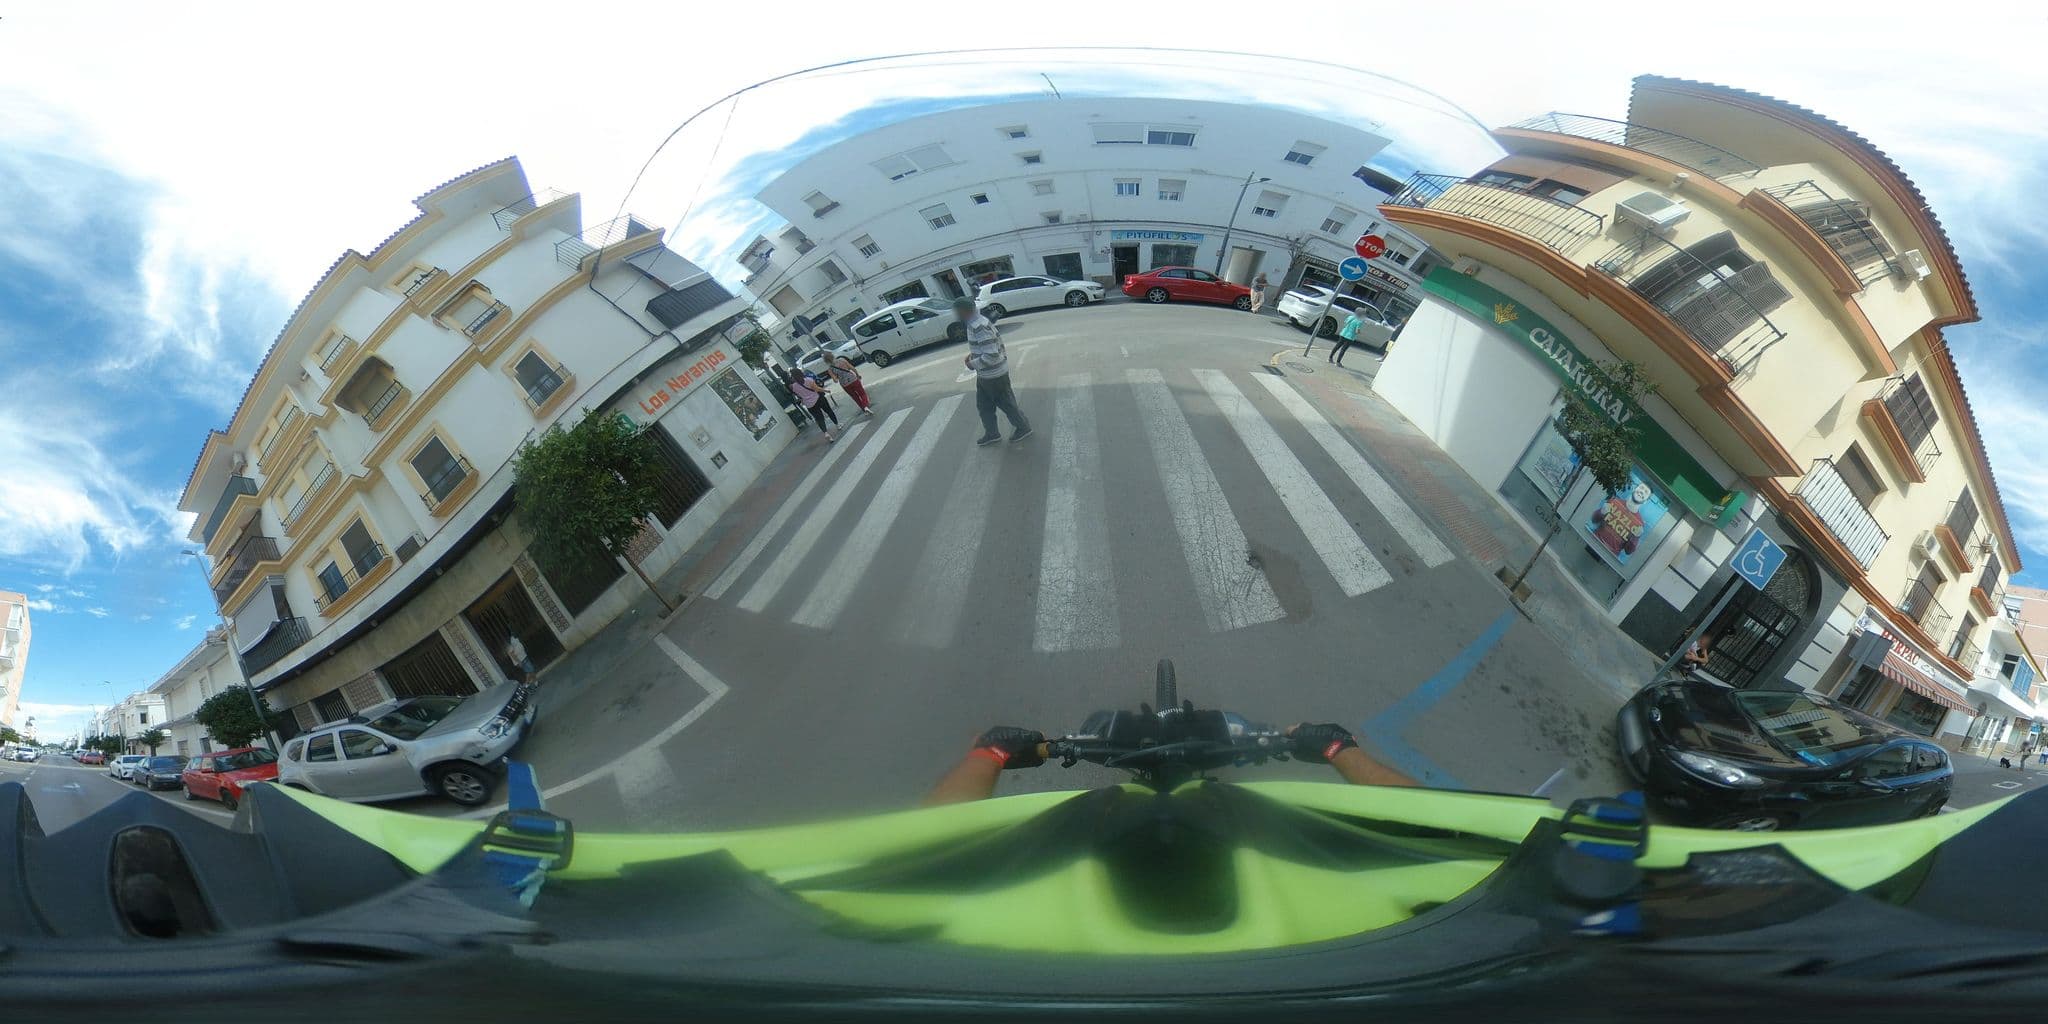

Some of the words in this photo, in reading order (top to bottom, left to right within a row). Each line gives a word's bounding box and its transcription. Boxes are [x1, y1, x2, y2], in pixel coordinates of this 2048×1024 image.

[1358, 239, 1383, 254] STOP
[639, 389, 671, 415] Los
[665, 349, 727, 392] Naranjos
